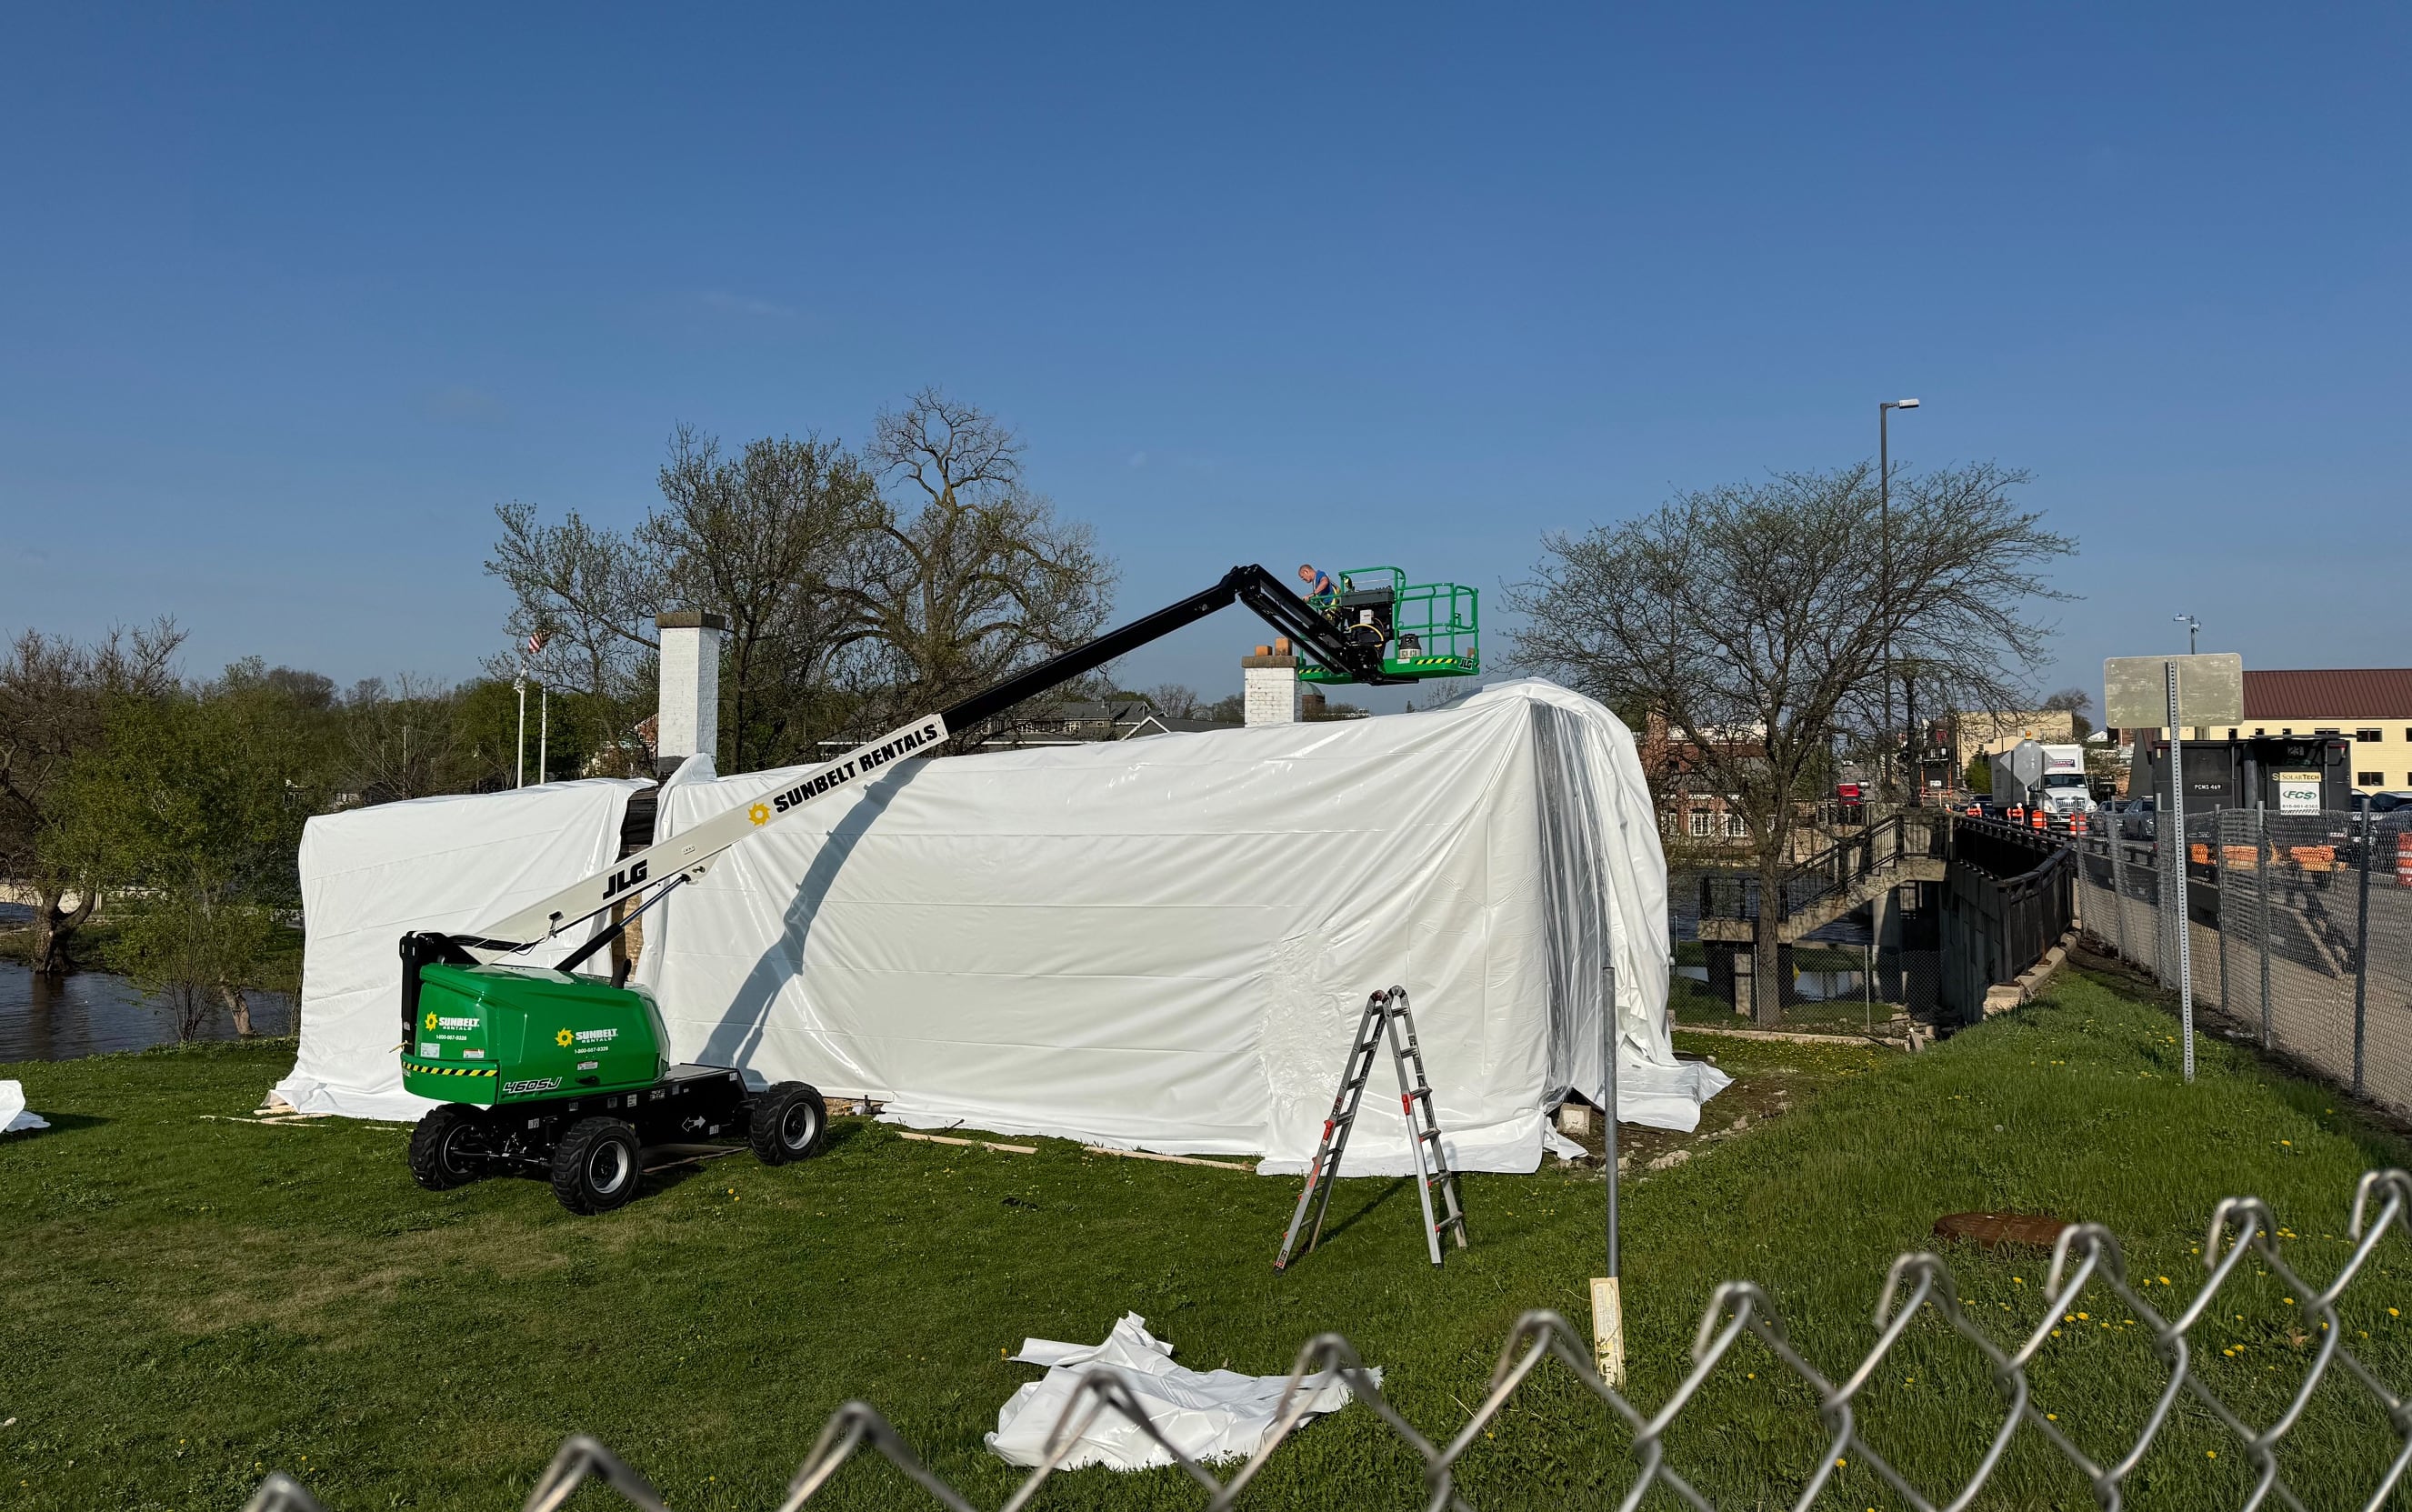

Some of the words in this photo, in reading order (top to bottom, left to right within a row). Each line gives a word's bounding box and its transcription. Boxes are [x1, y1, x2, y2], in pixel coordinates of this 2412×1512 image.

[1458, 657, 1474, 670] JLG
[773, 760, 856, 813] SUNBELT
[859, 724, 938, 773] RENTALS
[2287, 790, 2314, 800] FCS
[602, 858, 648, 901] JLG
[438, 1016, 480, 1027] SUNBELT
[575, 1028, 618, 1040] SUNBELT
[503, 1076, 563, 1094] 460SJ
